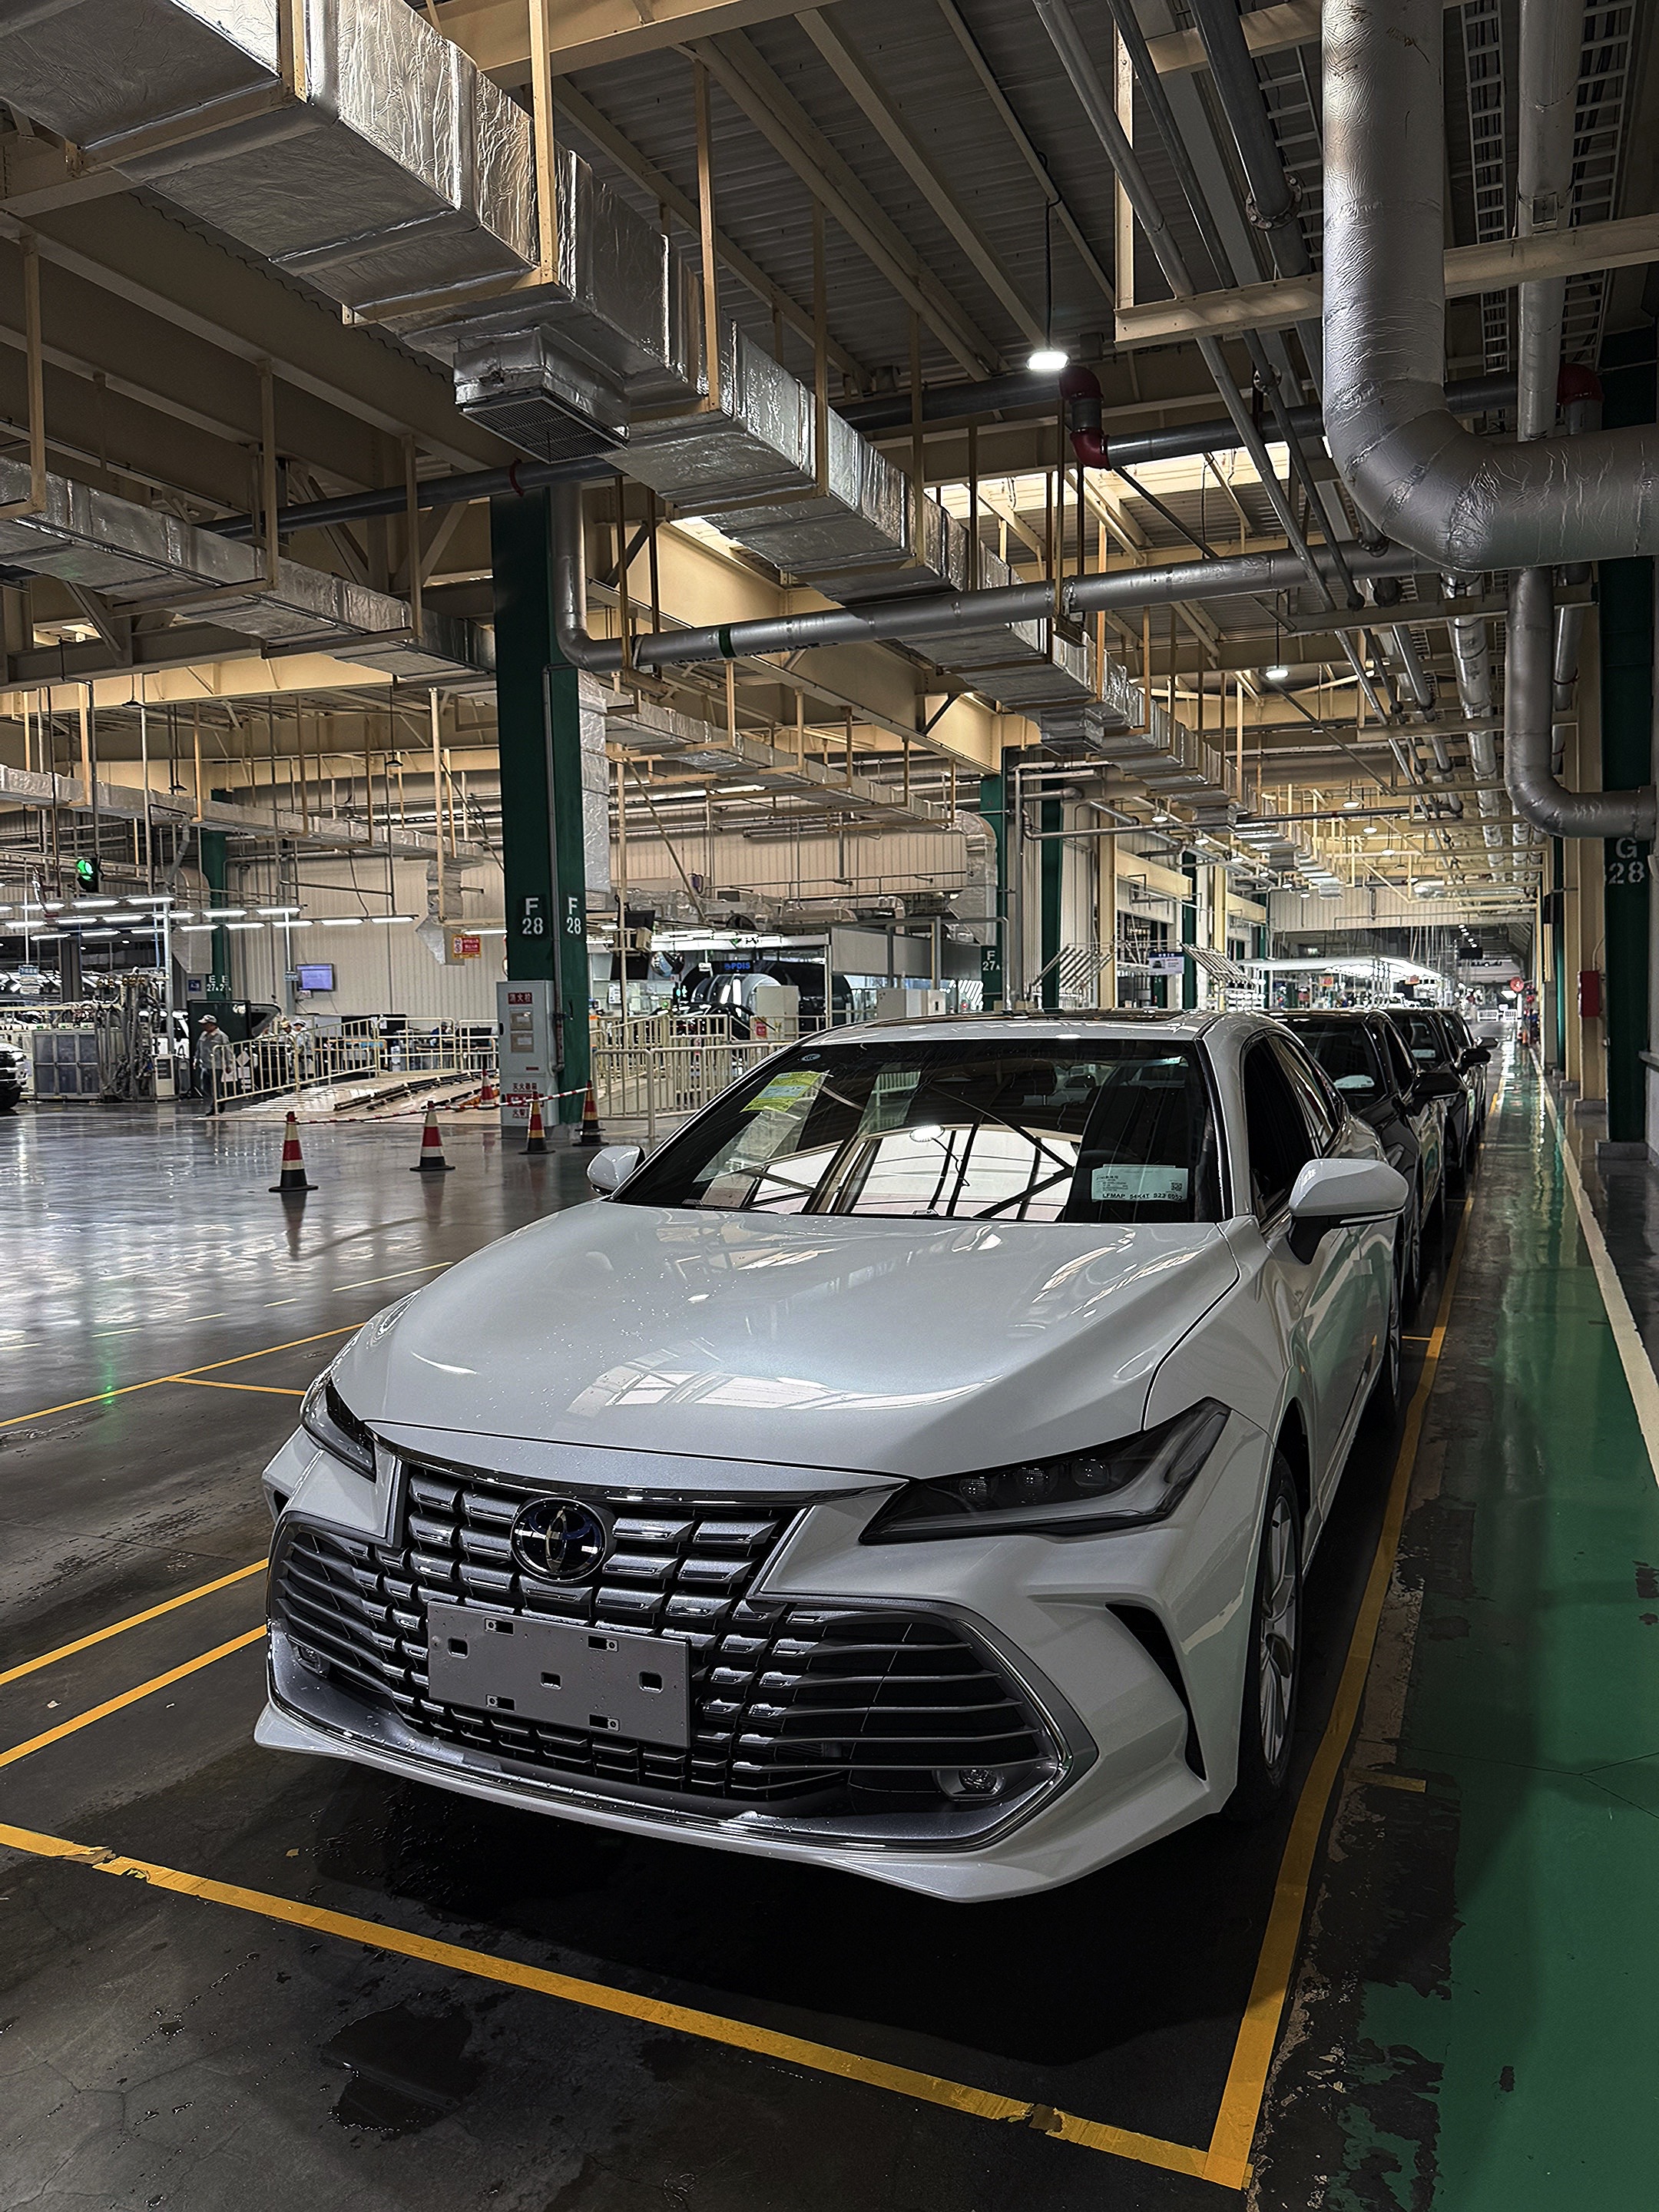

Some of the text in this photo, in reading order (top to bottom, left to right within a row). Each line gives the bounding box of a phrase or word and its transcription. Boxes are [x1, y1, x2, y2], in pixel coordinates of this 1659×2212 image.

[1615, 837, 1637, 859] G
[1608, 861, 1644, 884] 28
[525, 897, 539, 916] F
[568, 896, 578, 915] F
[522, 917, 543, 935] 28
[566, 916, 581, 935] 28
[987, 950, 995, 960] F
[209, 975, 216, 983] E
[221, 975, 229, 983] E
